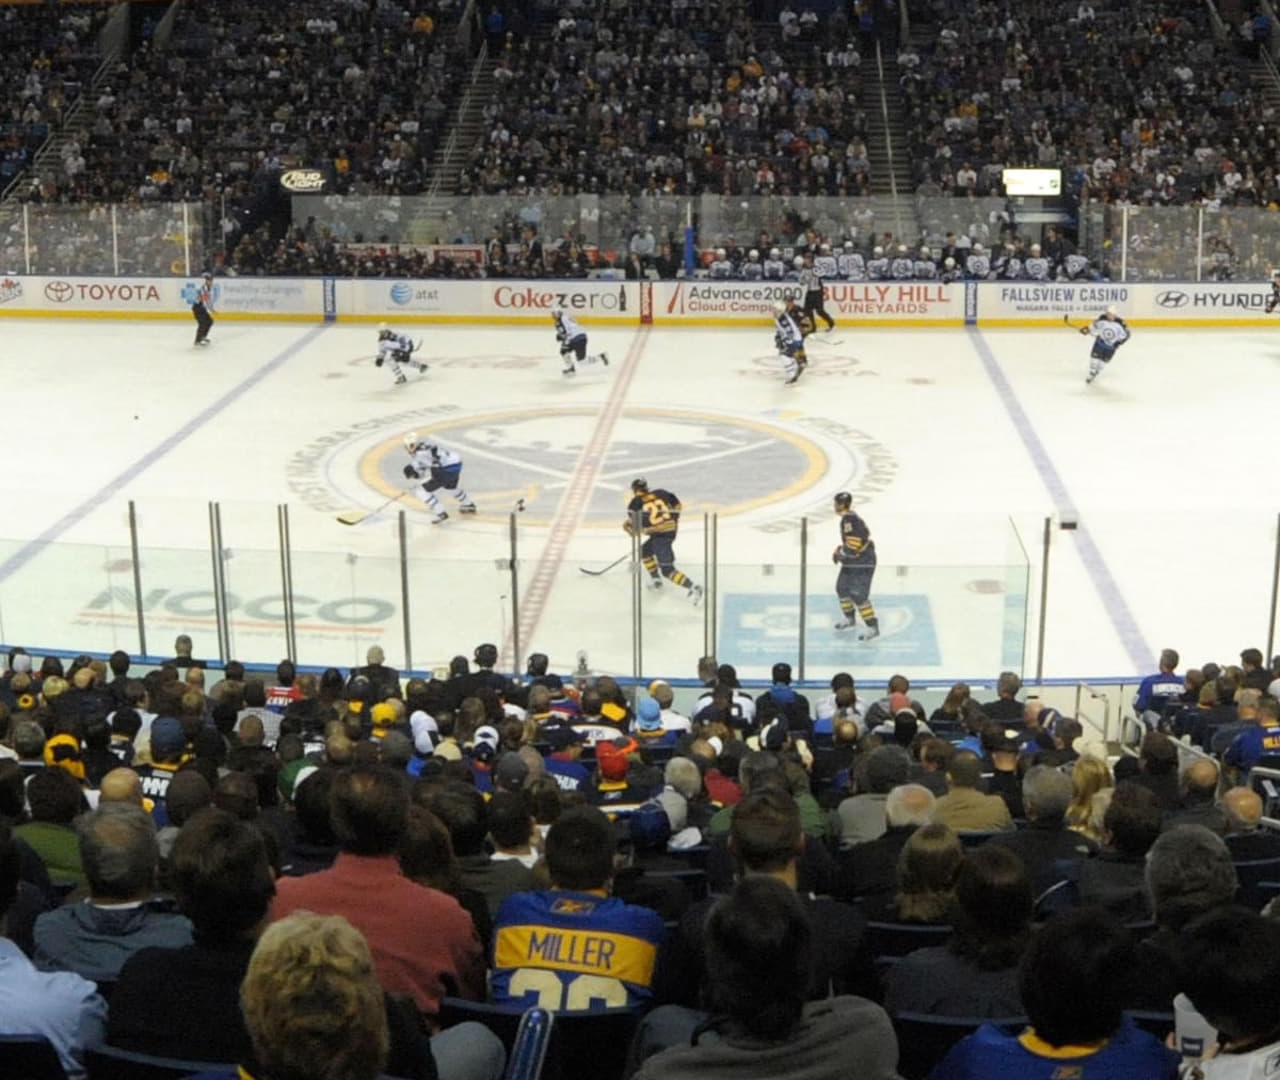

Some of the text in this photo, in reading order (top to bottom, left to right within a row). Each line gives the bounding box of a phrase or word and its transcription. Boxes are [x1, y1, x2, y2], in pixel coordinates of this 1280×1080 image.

[78, 284, 160, 302] TOYOTA
[688, 285, 803, 302] Advance2000
[822, 285, 891, 303] BULLY
[898, 284, 950, 303] HILL
[1001, 287, 1128, 302] FALLSVIEW CASINO
[1193, 292, 1274, 308] HYUND
[688, 301, 726, 313] Cloud
[838, 302, 928, 315] VINEYARDS
[86, 585, 396, 625] NOCO
[527, 931, 615, 970] MILLER
